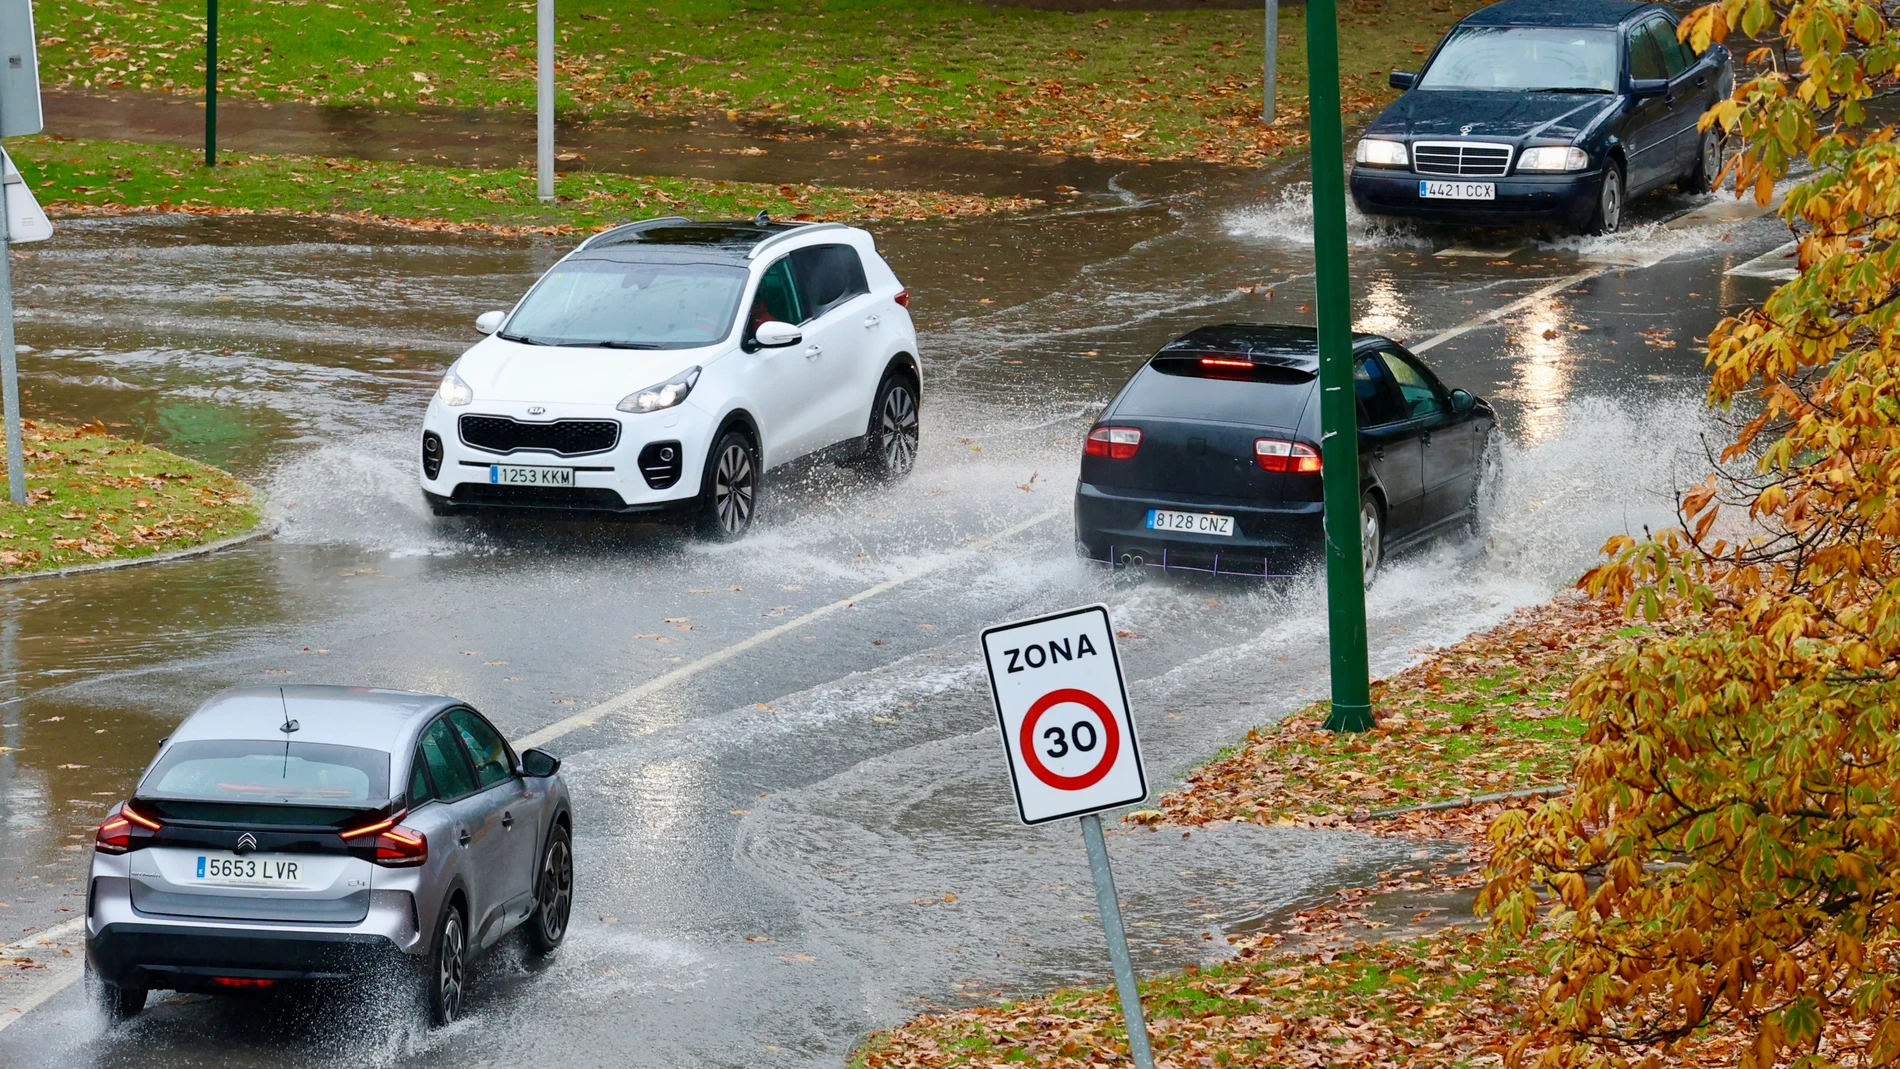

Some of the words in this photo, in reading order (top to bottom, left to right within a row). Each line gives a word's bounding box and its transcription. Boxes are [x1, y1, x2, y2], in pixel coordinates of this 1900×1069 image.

[1429, 185, 1460, 197] 4421
[1466, 185, 1491, 198] CCX
[528, 405, 545, 414] KIA
[502, 468, 537, 483] 1253
[542, 470, 570, 485] KKM
[1156, 512, 1194, 530] 8128
[1199, 516, 1229, 534] CNZ
[1003, 633, 1098, 674] ZONA
[1043, 720, 1098, 759] 30
[210, 858, 256, 879] 5653
[263, 861, 299, 880] LVR
[348, 878, 366, 887] C4
